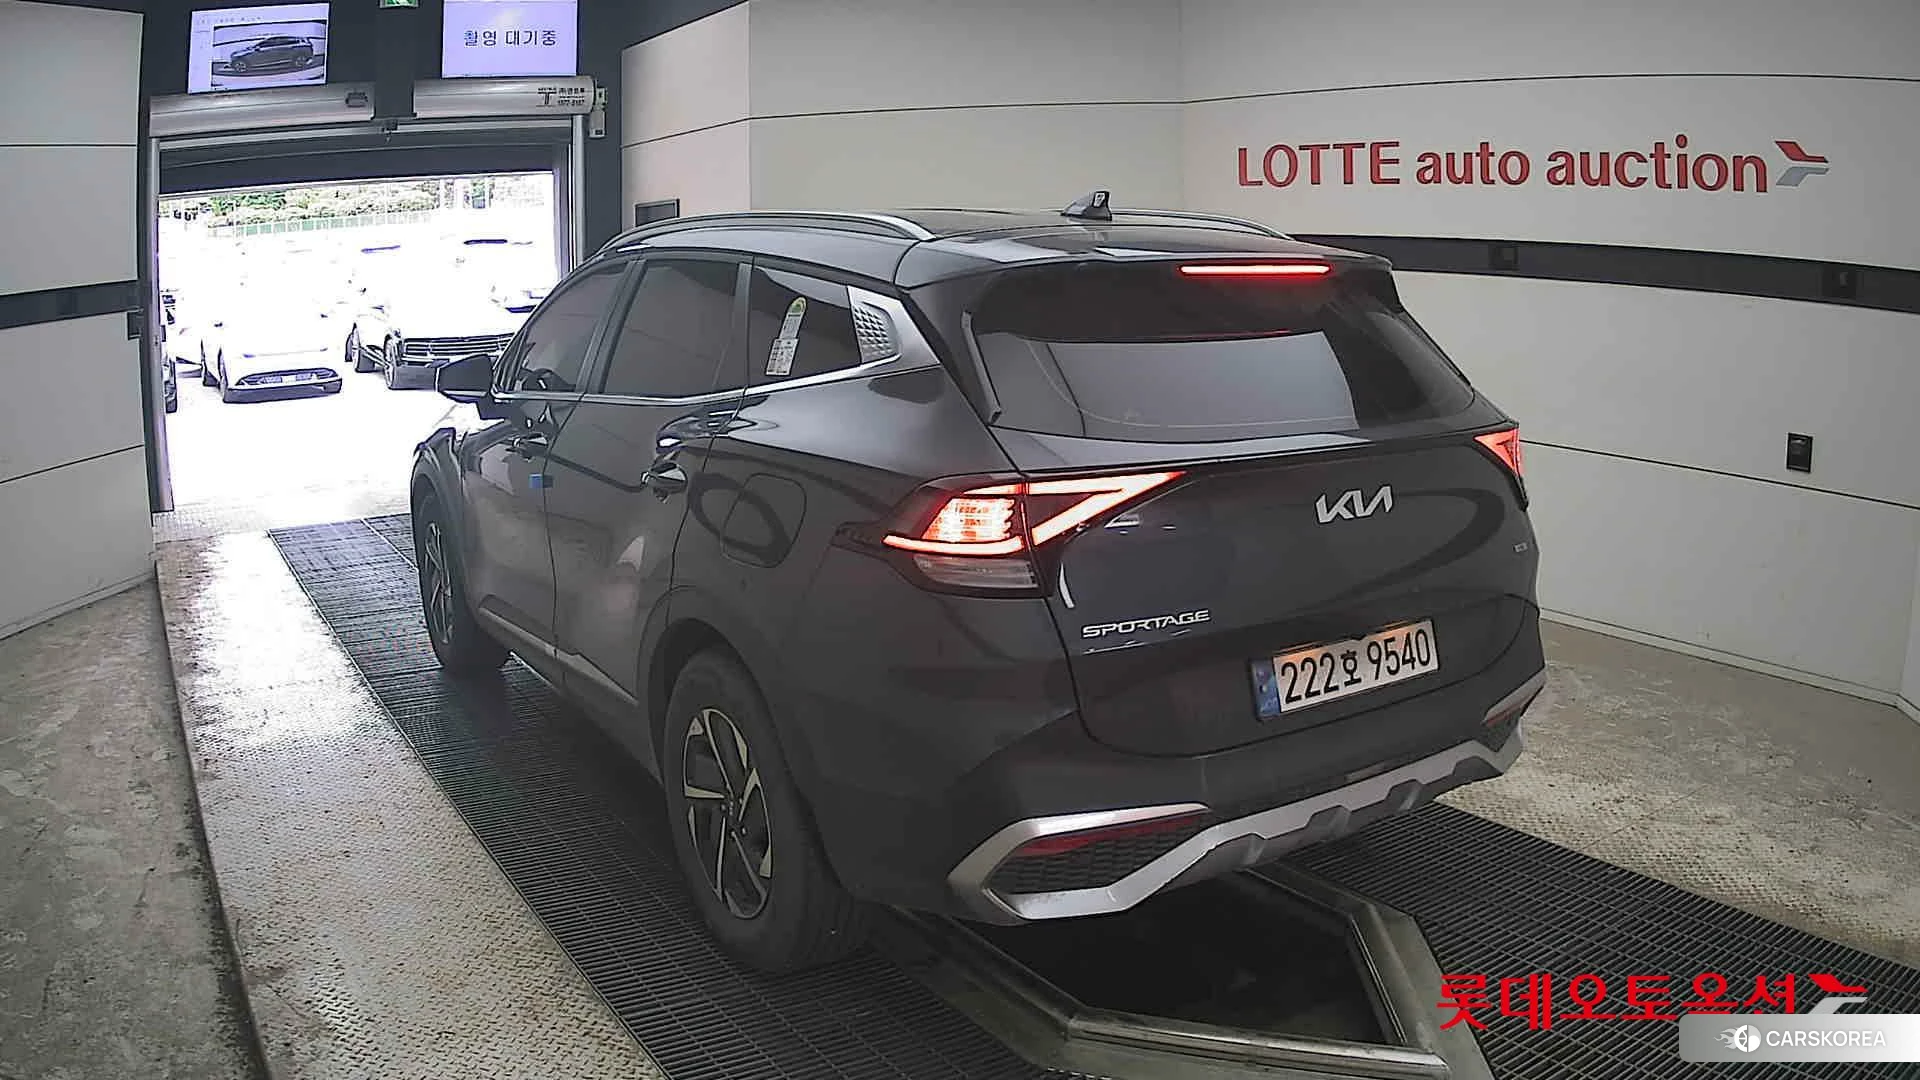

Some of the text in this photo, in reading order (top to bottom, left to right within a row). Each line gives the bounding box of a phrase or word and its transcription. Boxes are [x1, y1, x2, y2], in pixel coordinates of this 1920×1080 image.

[505, 30, 556, 46] 대기중
[1238, 134, 1767, 193] LOTTE auto auction
[1315, 486, 1392, 523] KIA
[1083, 609, 1210, 638] SPORTAGE
[1281, 629, 1431, 704] 222호 9540
